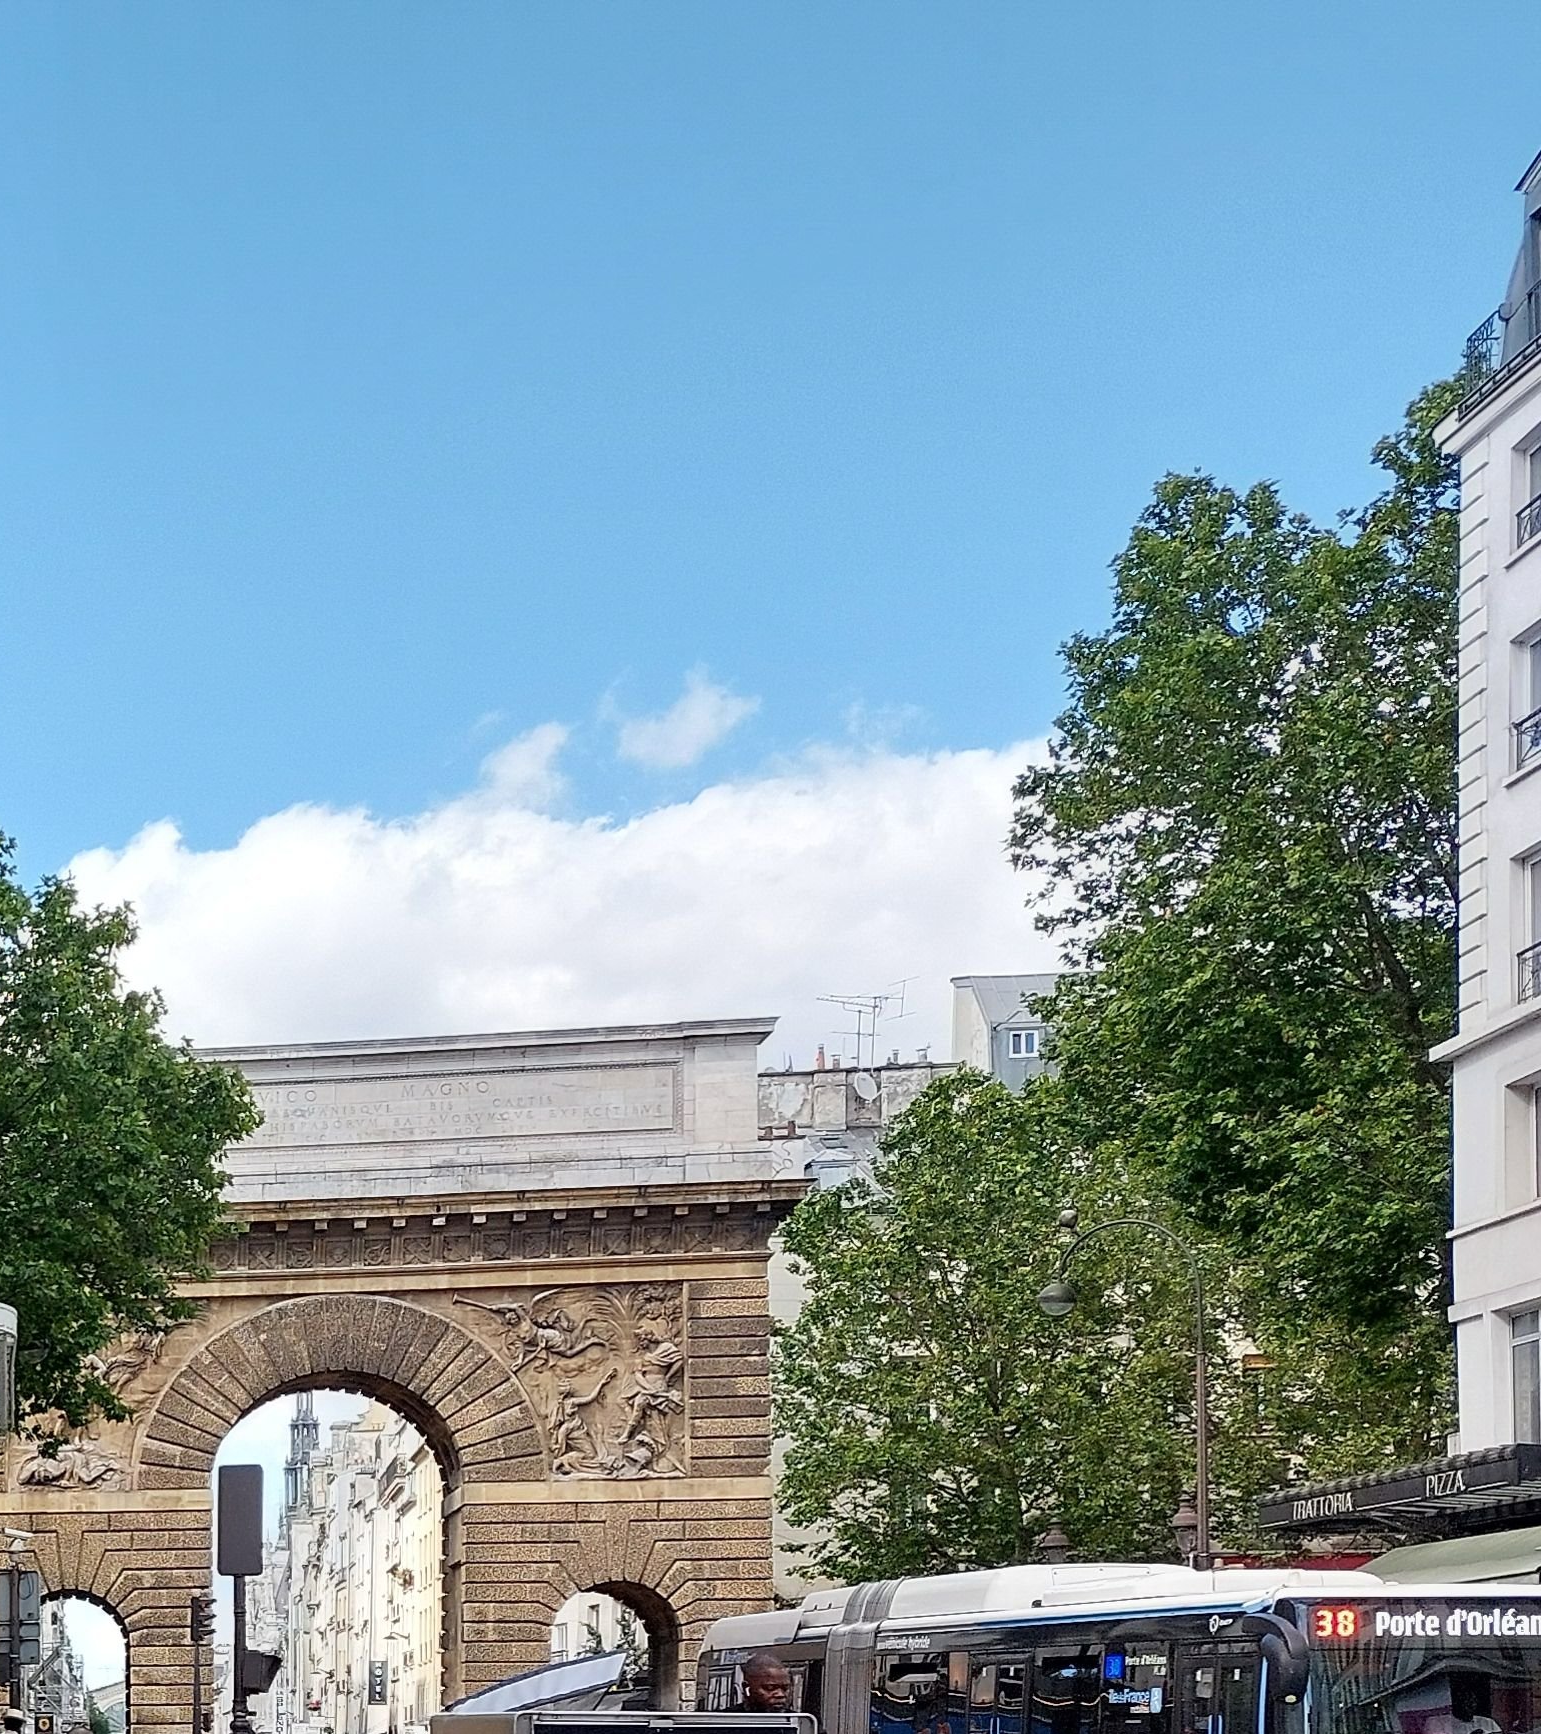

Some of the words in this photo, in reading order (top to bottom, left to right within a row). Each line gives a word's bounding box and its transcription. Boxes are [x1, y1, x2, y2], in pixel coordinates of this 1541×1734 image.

[401, 1081, 490, 1098] MAGNO
[1292, 1491, 1356, 1521] TRATTORIA
[1425, 1469, 1466, 1498] PIZZA
[1315, 1609, 1356, 1638] 38
[1375, 1610, 1440, 1637] Porte
